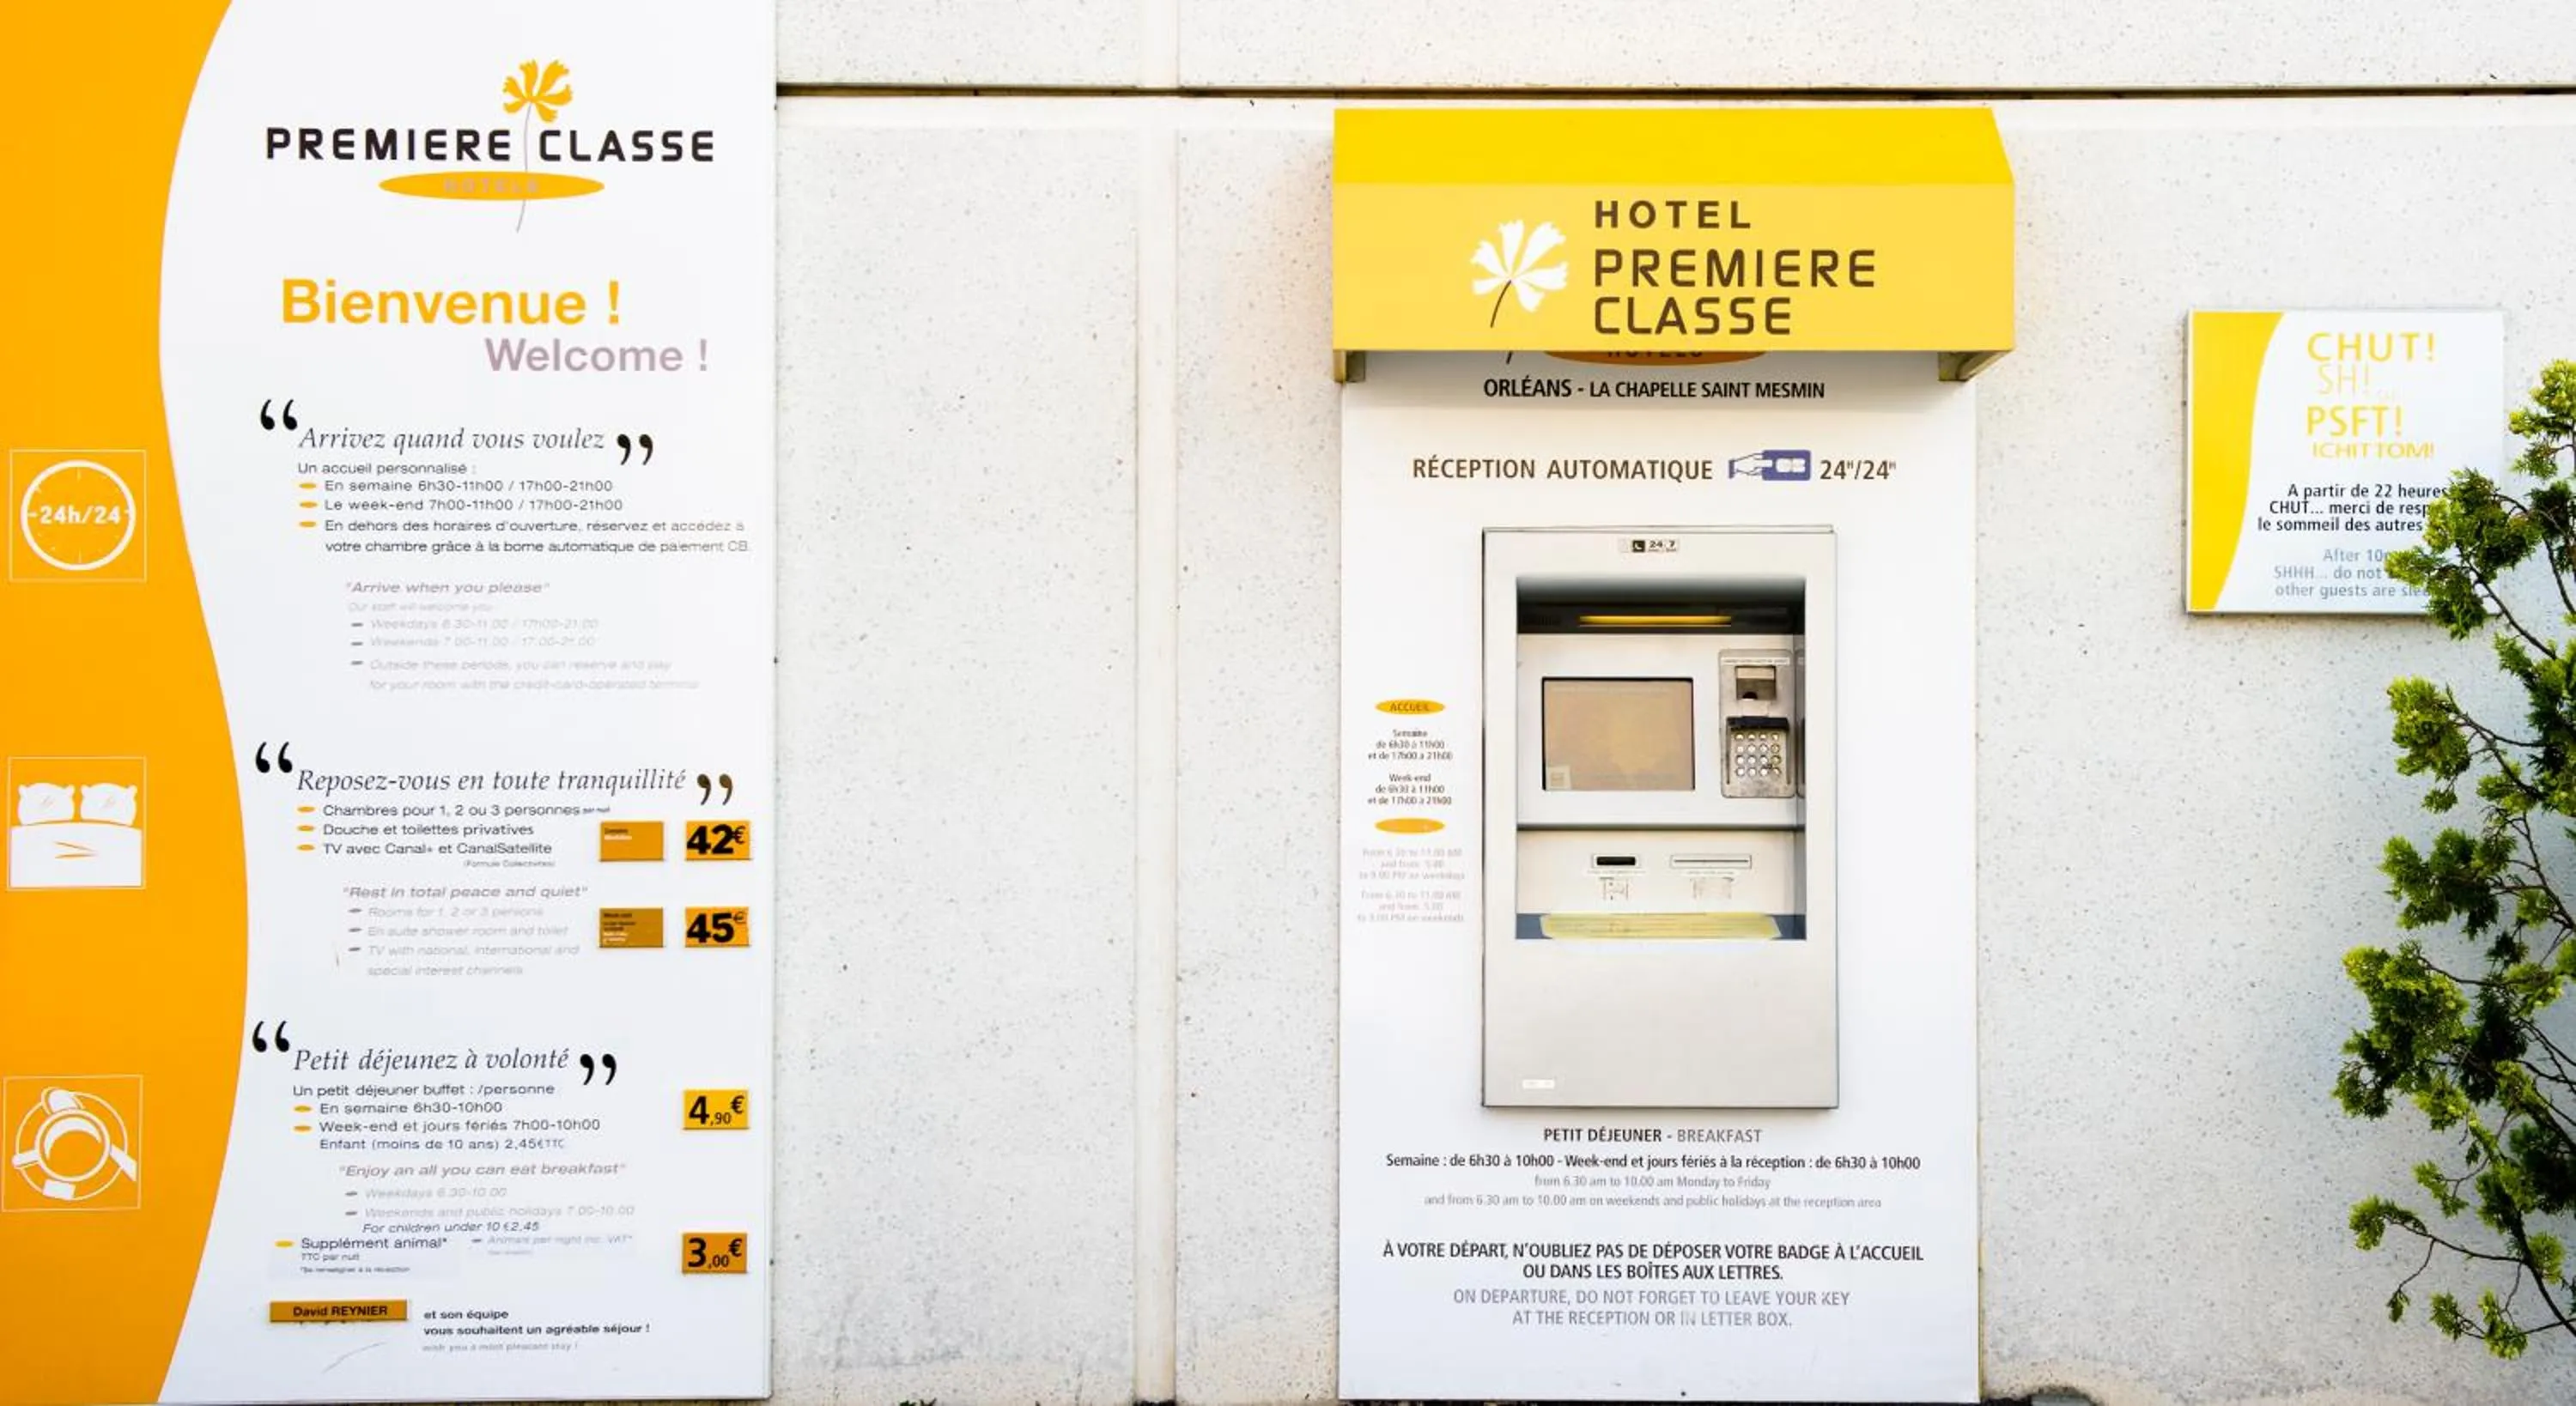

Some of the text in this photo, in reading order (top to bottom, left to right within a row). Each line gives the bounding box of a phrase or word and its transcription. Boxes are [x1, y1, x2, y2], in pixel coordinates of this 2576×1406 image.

[266, 126, 714, 162] PREMIERE CLASSE
[1595, 200, 1751, 229] HOTEL
[1595, 248, 1875, 288] PREMIERE
[282, 278, 619, 326] Bienvenue !
[1595, 296, 1791, 336] CLASSE
[484, 337, 708, 372] Welcome !
[2307, 332, 2433, 361] CHUT!
[1484, 376, 1824, 398] ORLÉANS LA CHAPELLE SAINT MESMIN
[2307, 405, 2402, 435] PSFT!
[299, 427, 604, 456] Arrivez quand vous voulez
[298, 463, 467, 476] Un accueil personnalisé
[1413, 454, 1713, 483] RÉCEPTION AUTOMATIQUE
[325, 480, 613, 492] En semaine 6h30-11h00 17h00-21h00
[2287, 484, 2298, 496] A
[2304, 484, 2345, 500] partir
[2351, 484, 2368, 497] de
[2375, 484, 2391, 497] 22
[325, 499, 623, 511] Le week-end 7h00-11h00 17h00-21h00
[2270, 500, 2394, 514] CHUT... merci de
[325, 519, 666, 531] En dehors des horaires d'ouverture, réservez et
[2258, 518, 2423, 531] le sommeil des autres
[2275, 585, 2396, 599] other guests are
[297, 768, 686, 797] Reposez-vous en toute tranquillité
[323, 804, 398, 816] Chambres
[403, 807, 434, 818] pour
[440, 805, 450, 816] 1,
[455, 804, 464, 816] 2
[469, 807, 487, 816] ou
[490, 804, 501, 816] 3
[505, 806, 580, 817] personnes
[323, 824, 534, 837] Douche et toilettes privatives
[323, 842, 552, 854] TV avec Canal+ et CanalSatellite
[686, 824, 746, 856] 42€
[686, 911, 748, 943] 45€
[294, 1047, 568, 1077] Petit déjeunez à volonté
[294, 1084, 555, 1099] Un petit déjeuner buffet /personne
[320, 1102, 502, 1114] En semaine 6h30-10h00
[319, 1119, 600, 1133] Week-end et jours fériés 7h00-10h00
[1544, 1126, 1761, 1142] PETIT DÉJEUNER BREAKFAST
[1386, 1154, 1921, 1171] Semaine de 6h30 à 10h00 Week-end et jours fériés à la réception de 6h30 à 10h00
[301, 1238, 389, 1251] Supplément
[1383, 1239, 1924, 1261] À VOTRE DÉPART, N'OUBLIEZ PAS DE DÉPOSER VOTRE BADGE À L'ACCUEIL
[1523, 1262, 1783, 1279] OU DANS LES BOÎTES AUX LETTRES.
[1454, 1288, 1850, 1306] ON DEPARTURE, DO NOT FORGET TO LEAVE YOUR KEY
[294, 1306, 387, 1317] David REYNIER
[424, 1311, 436, 1319] et
[467, 1310, 508, 1320] équipe
[457, 1325, 523, 1335] souhaitent
[546, 1325, 600, 1336] agréable
[604, 1324, 642, 1335] séjour
[646, 1324, 649, 1332] !
